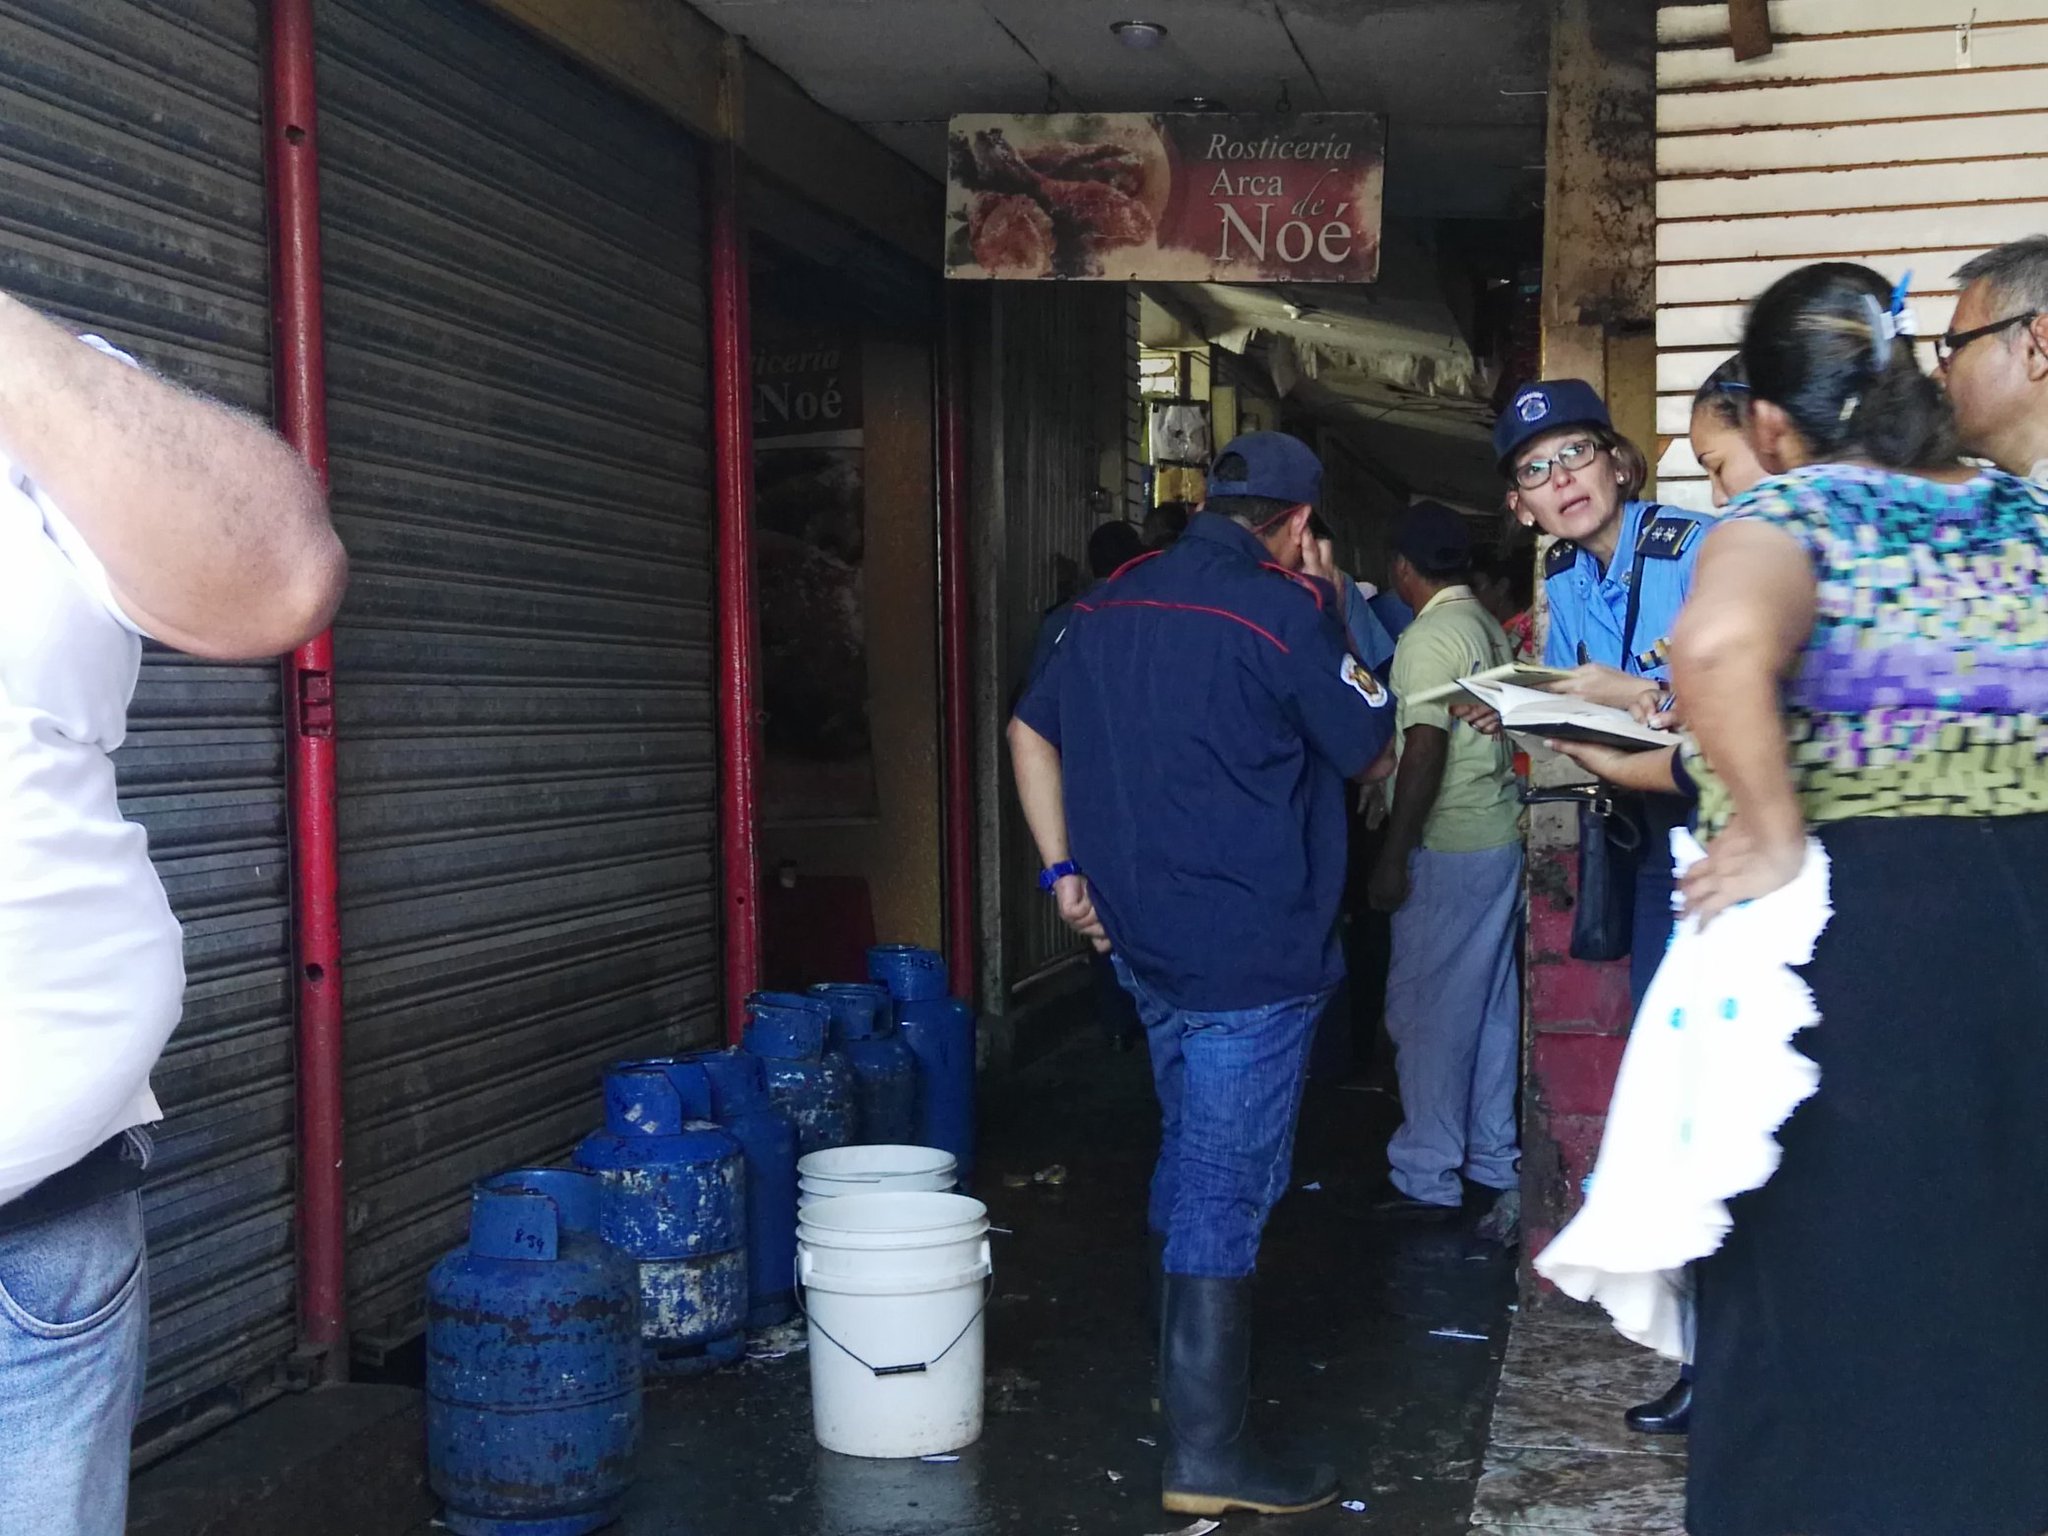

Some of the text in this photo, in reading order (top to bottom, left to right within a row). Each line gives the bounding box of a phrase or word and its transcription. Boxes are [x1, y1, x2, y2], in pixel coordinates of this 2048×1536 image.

[1206, 133, 1351, 159] Rosticería
[1210, 168, 1339, 217] Arca de
[1214, 203, 1351, 263] Noé
[755, 376, 842, 423] Noé
